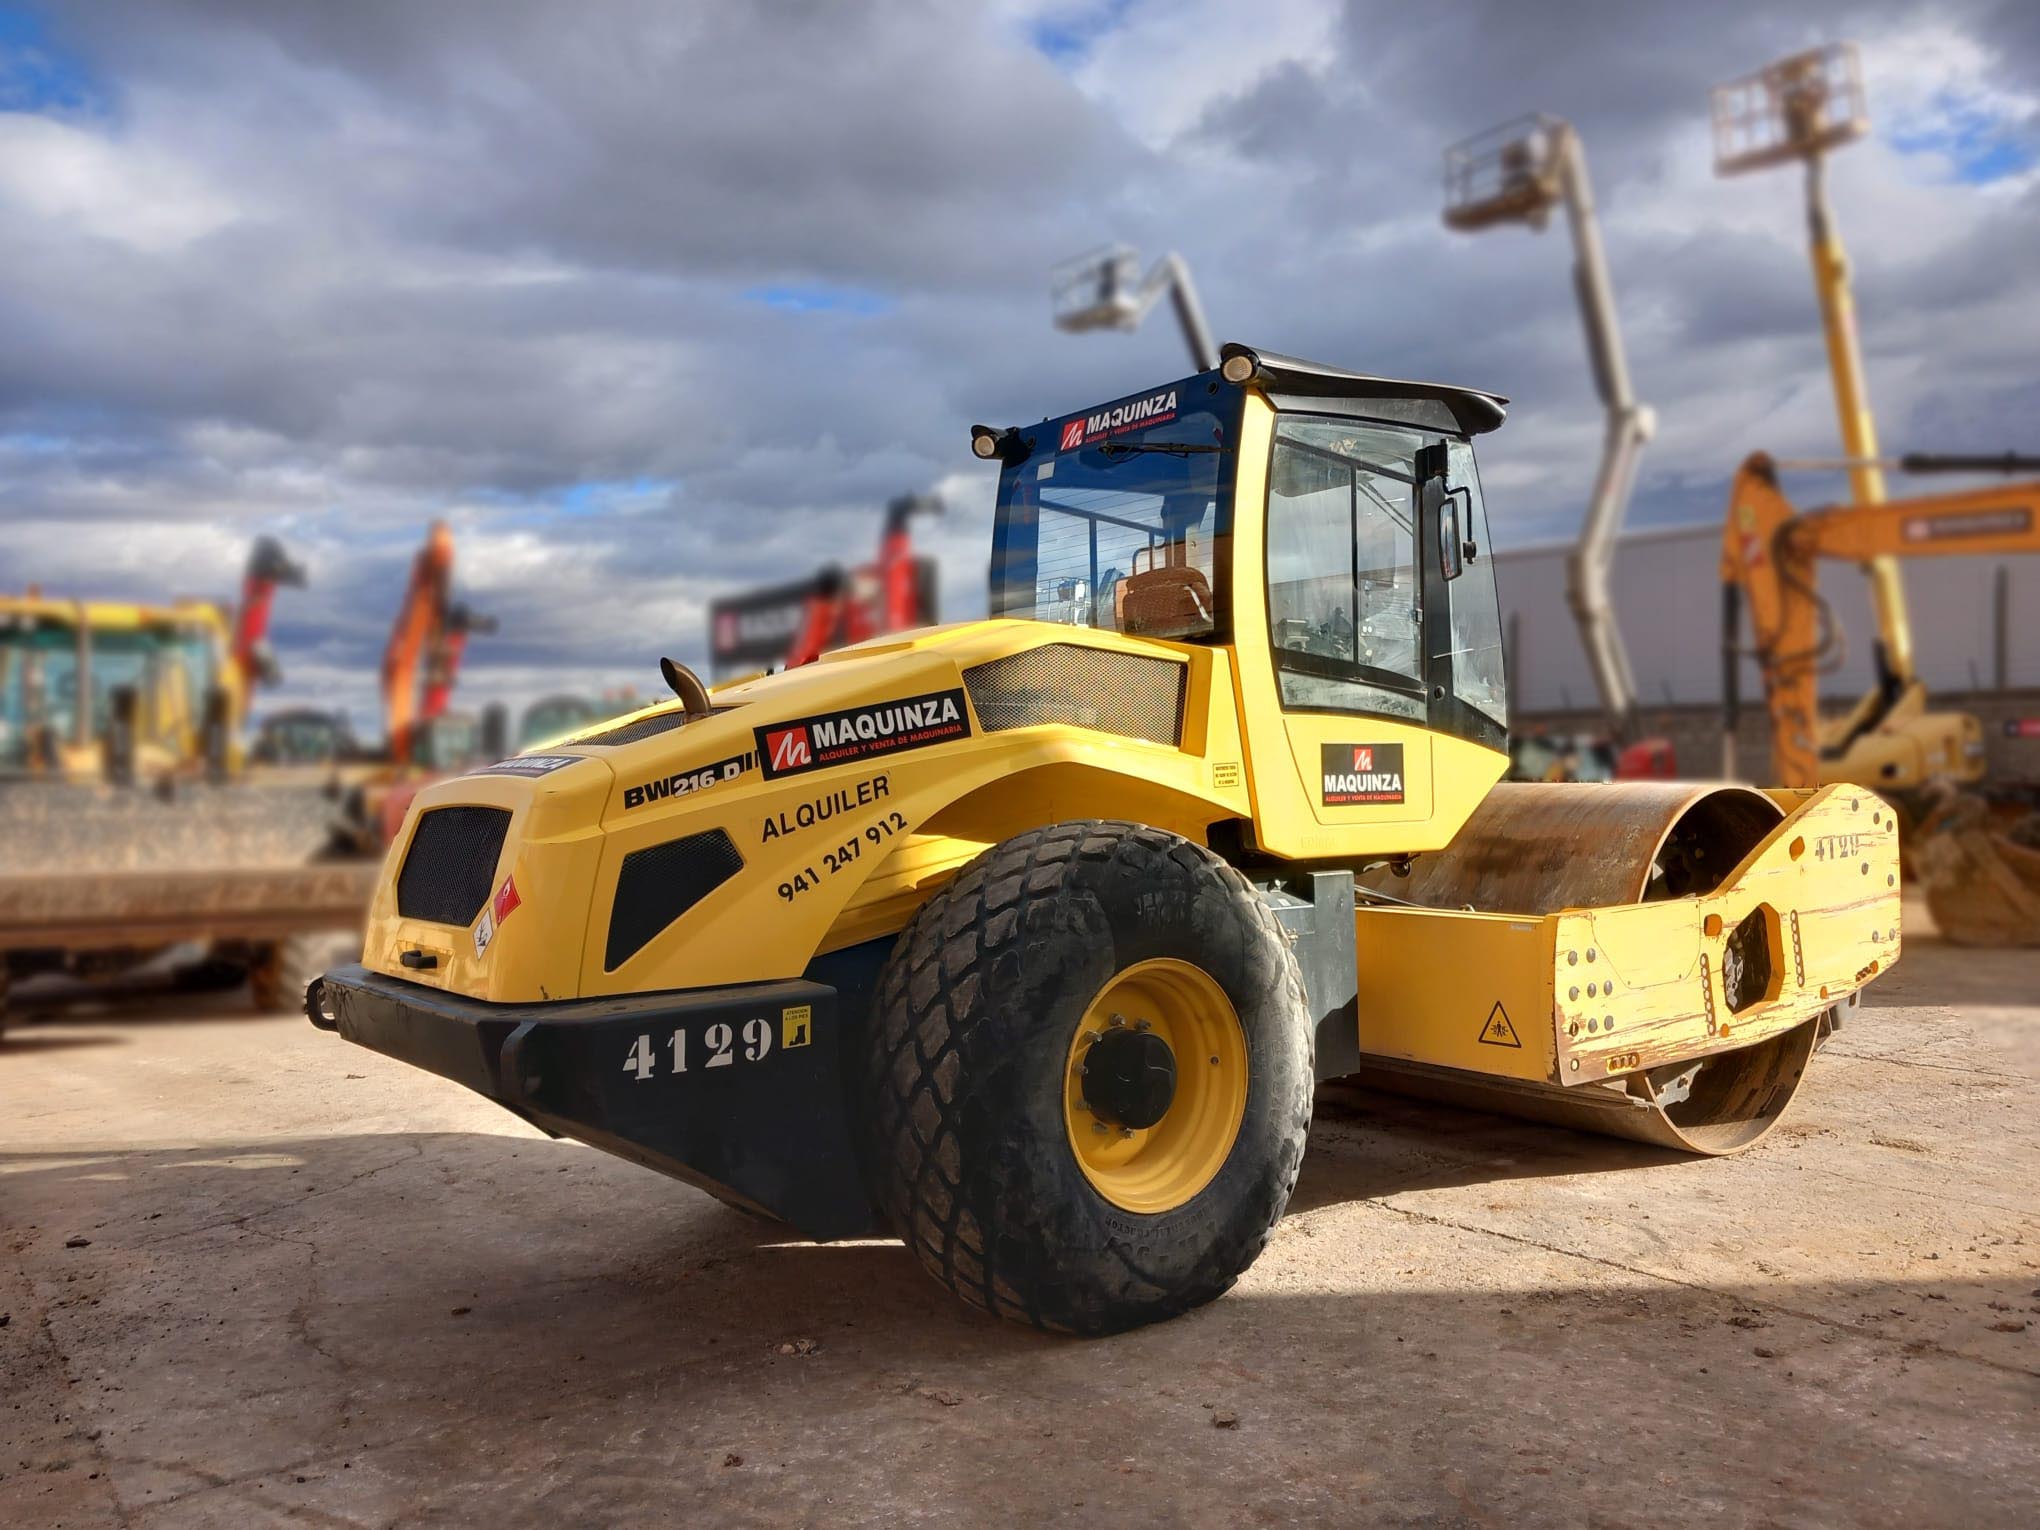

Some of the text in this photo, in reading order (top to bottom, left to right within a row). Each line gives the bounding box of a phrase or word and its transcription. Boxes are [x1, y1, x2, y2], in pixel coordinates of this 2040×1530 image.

[1086, 391, 1177, 434] MAQUINZA
[812, 698, 960, 749] MAQUINZA
[819, 724, 962, 762] ALQUILER Y VENTA DE MAQUINARIA
[1324, 774, 1402, 792] MAQUINZA
[762, 775, 889, 843] ALQUILER
[777, 812, 908, 903] 941 247 912
[622, 1018, 773, 1080] 4129
